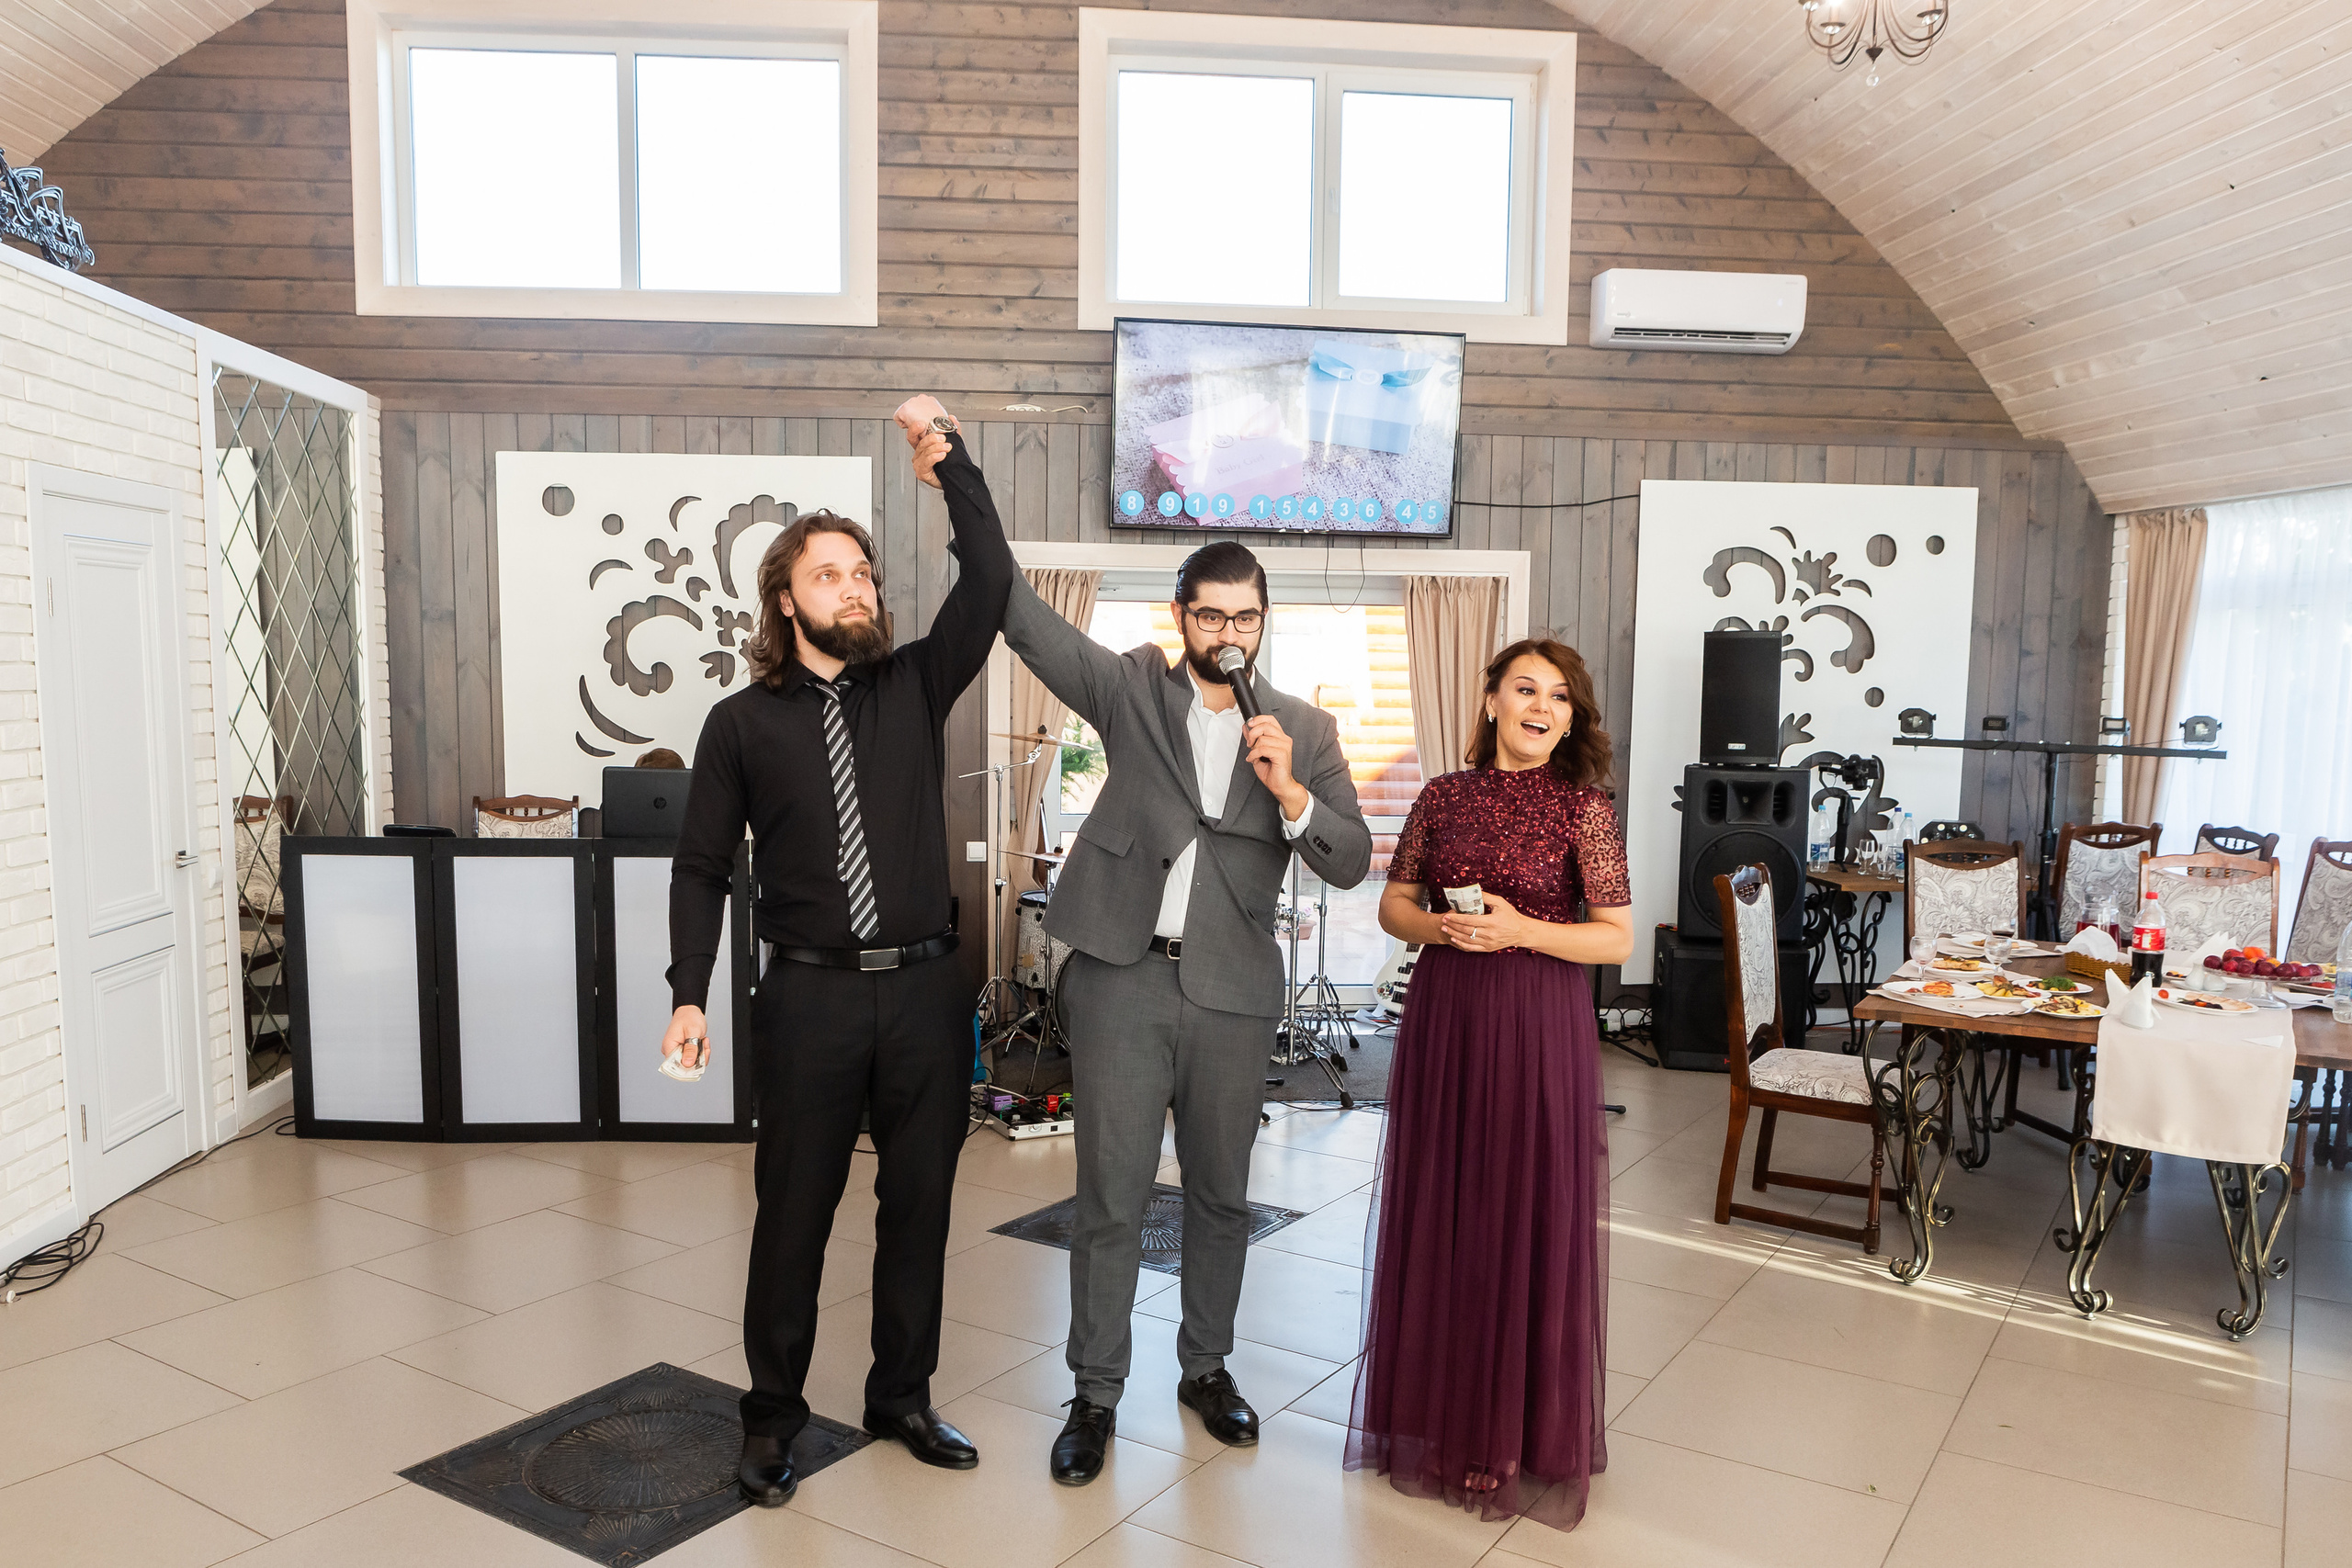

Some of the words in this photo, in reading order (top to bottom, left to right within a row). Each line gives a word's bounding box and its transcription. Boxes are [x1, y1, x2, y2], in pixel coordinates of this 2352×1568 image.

[1126, 495, 1136, 511] 8
[1165, 497, 1227, 513] 919
[1257, 500, 1318, 516] 154
[1340, 502, 1374, 518] 36
[1401, 504, 1437, 520] 45
